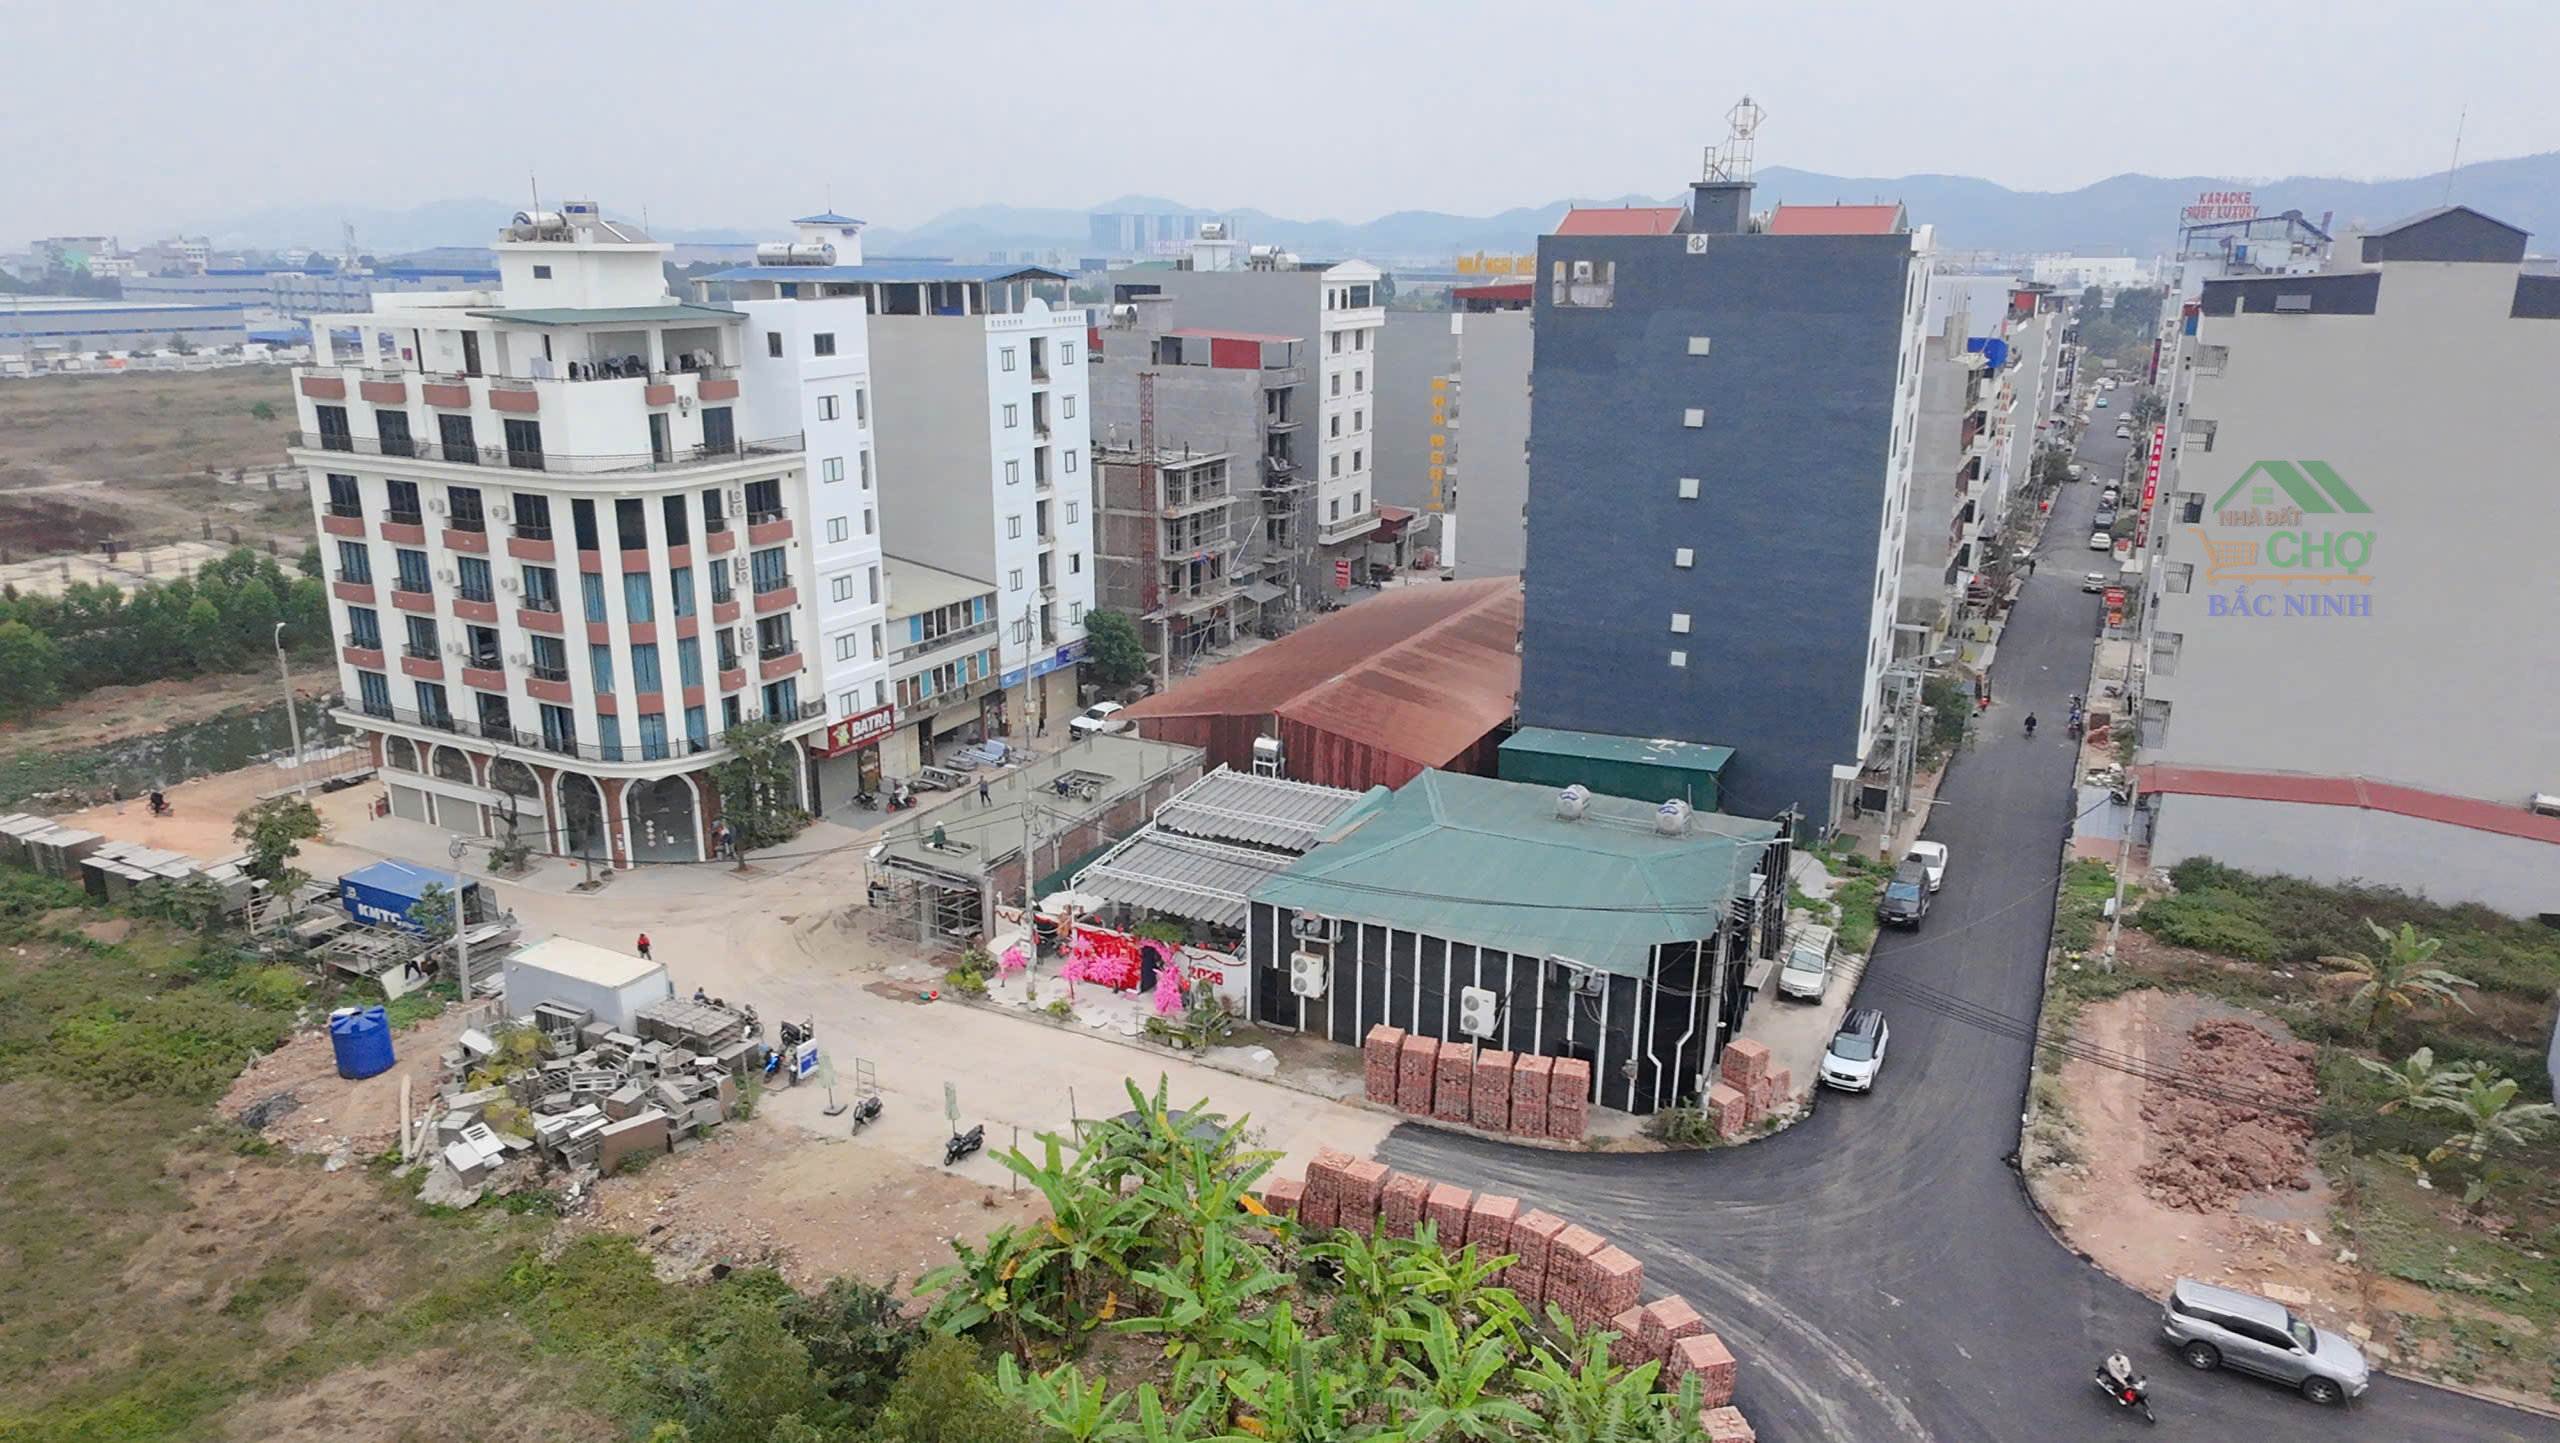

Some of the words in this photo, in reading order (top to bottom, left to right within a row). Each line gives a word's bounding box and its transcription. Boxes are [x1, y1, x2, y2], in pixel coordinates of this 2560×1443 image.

[2199, 191, 2251, 204] KARAOKE
[2217, 206, 2259, 219] LUXURY
[852, 710, 891, 738] BATRA
